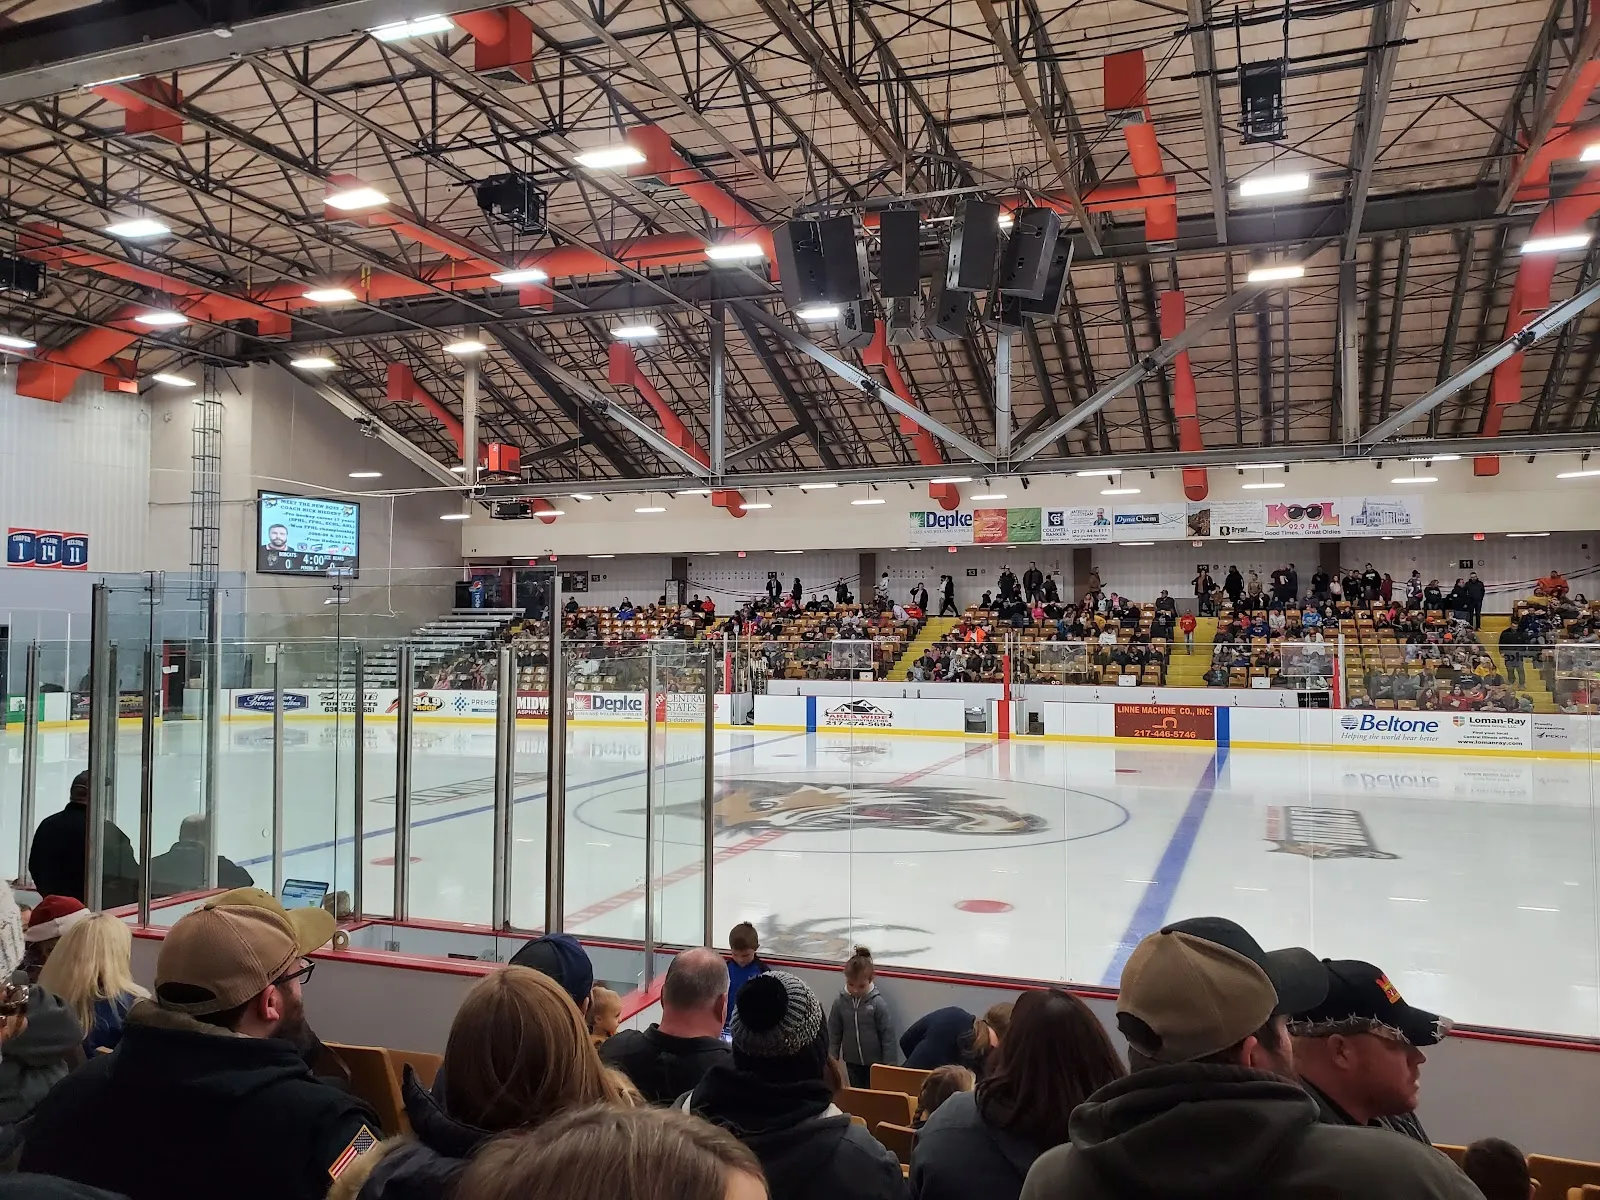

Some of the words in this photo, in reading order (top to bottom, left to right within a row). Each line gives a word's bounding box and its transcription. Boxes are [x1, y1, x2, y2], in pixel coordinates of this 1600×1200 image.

[926, 510, 973, 530] Depke
[1231, 526, 1248, 534] Bryant
[19, 543, 24, 560] 1
[42, 545, 56, 561] 14
[70, 547, 80, 562] 11
[285, 559, 290, 569] 0
[302, 554, 324, 566] 4:00
[592, 695, 642, 713] Depke
[667, 703, 697, 712] STATES
[1117, 706, 1140, 714] LINNE
[1141, 707, 1176, 715] MACHINE
[1179, 708, 1195, 716] CO.,
[1196, 708, 1213, 716] INC.
[1360, 714, 1439, 733] Beltone
[1469, 717, 1526, 726] Loman-Ray
[1134, 729, 1196, 738] 217-446-5746
[1341, 732, 1368, 740] Helping
[1369, 732, 1380, 740] the
[1403, 733, 1418, 741] hear
